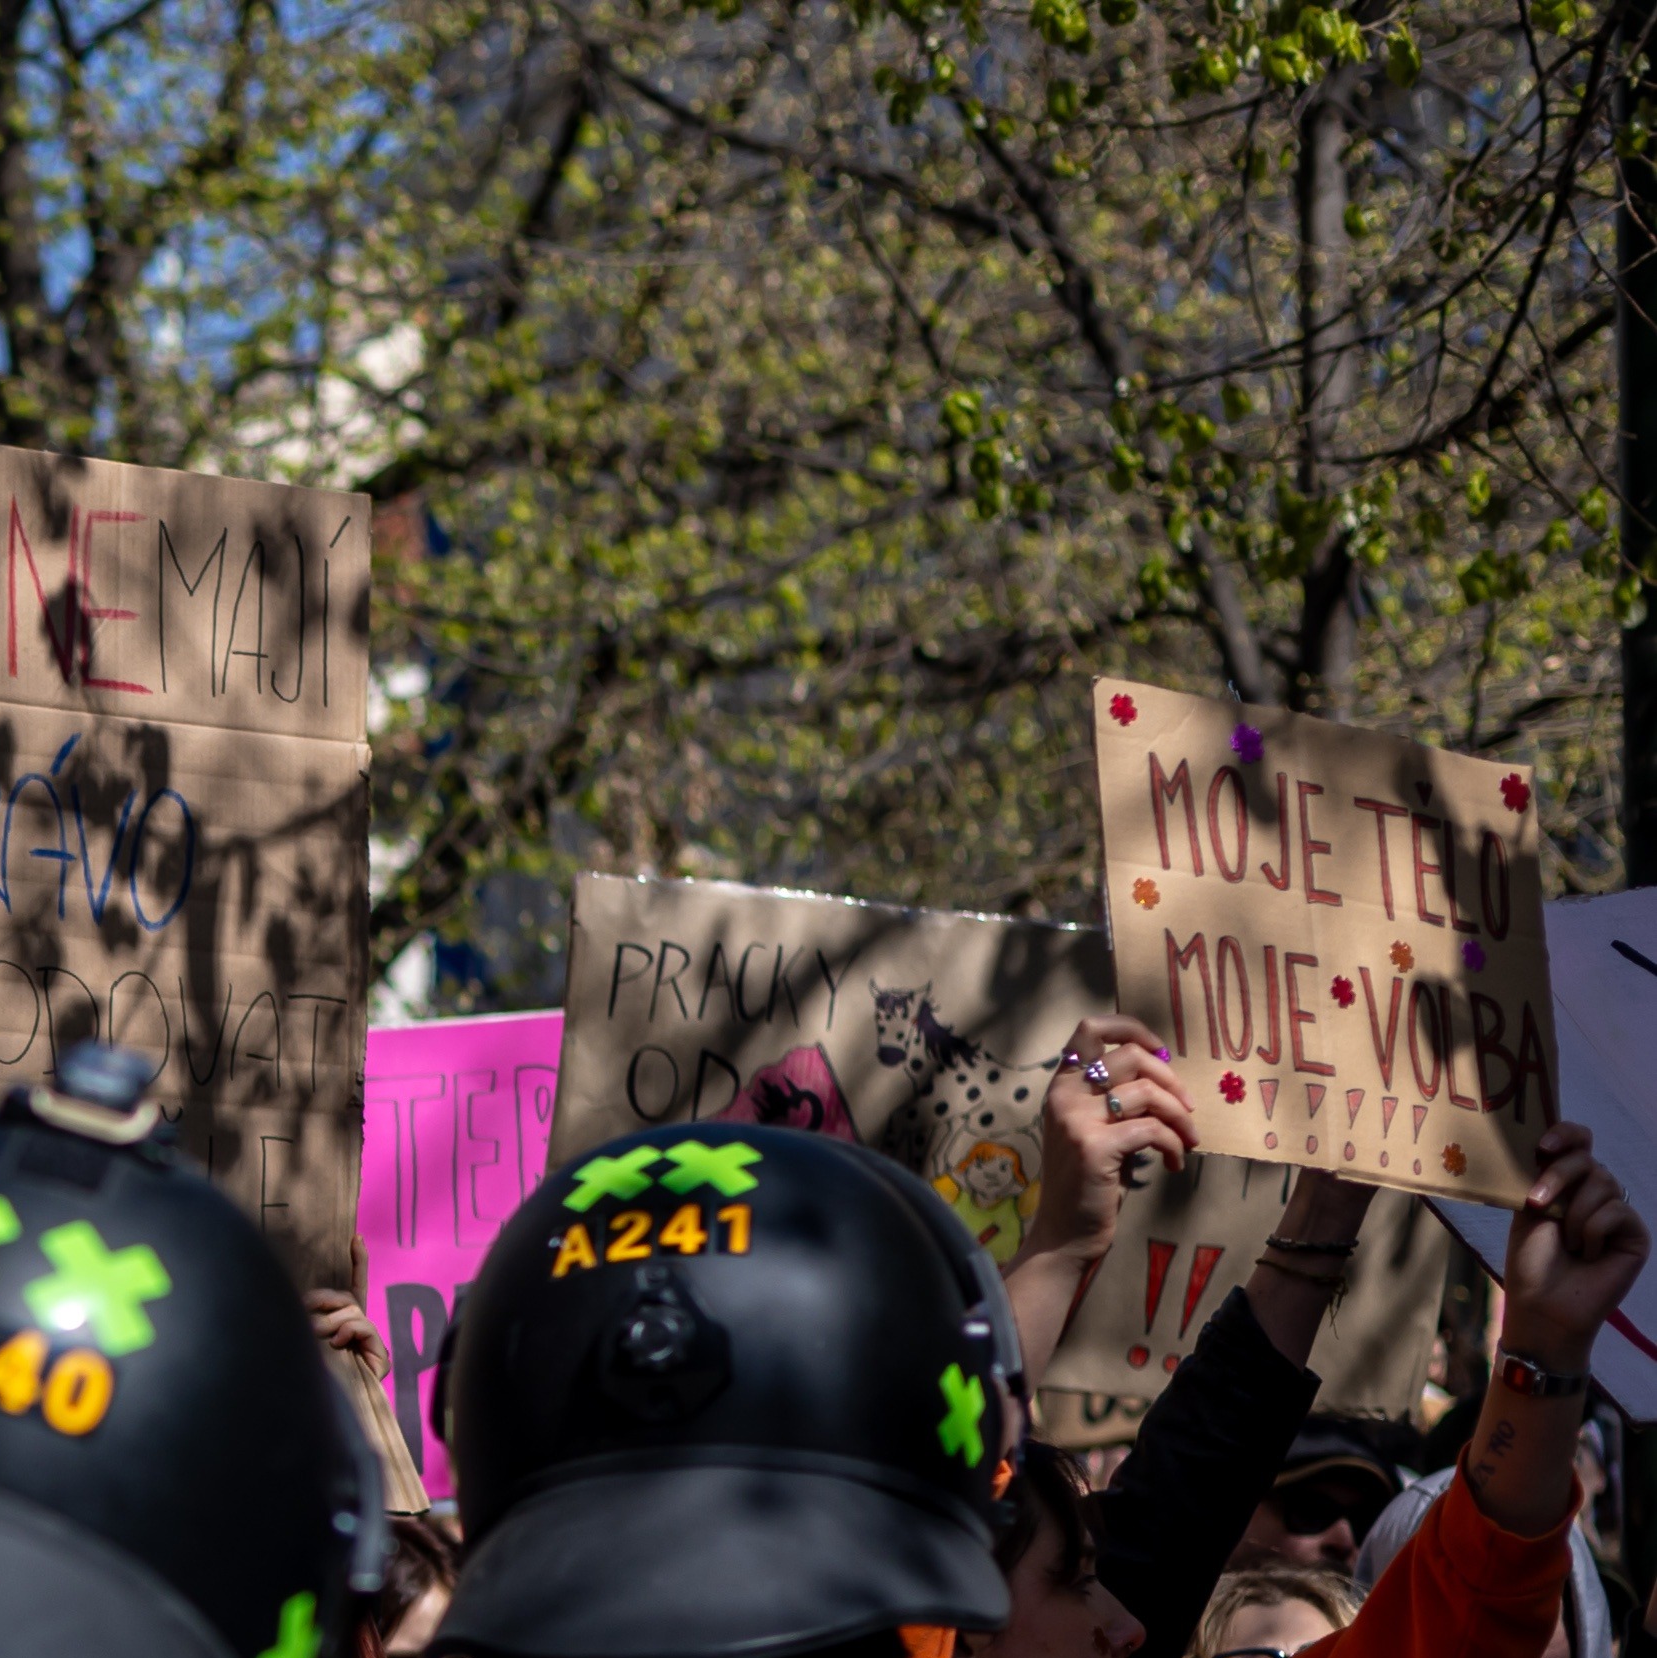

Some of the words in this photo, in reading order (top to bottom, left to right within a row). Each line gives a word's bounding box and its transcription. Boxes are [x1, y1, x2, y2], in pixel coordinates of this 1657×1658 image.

[1148, 752, 1343, 908] MOJE
[1353, 780, 1511, 942] TĚLO
[608, 941, 861, 1032] PRACKY
[1164, 927, 1337, 1078] MOJE
[1357, 966, 1563, 1132] VOLBA
[551, 1202, 752, 1278] A241
